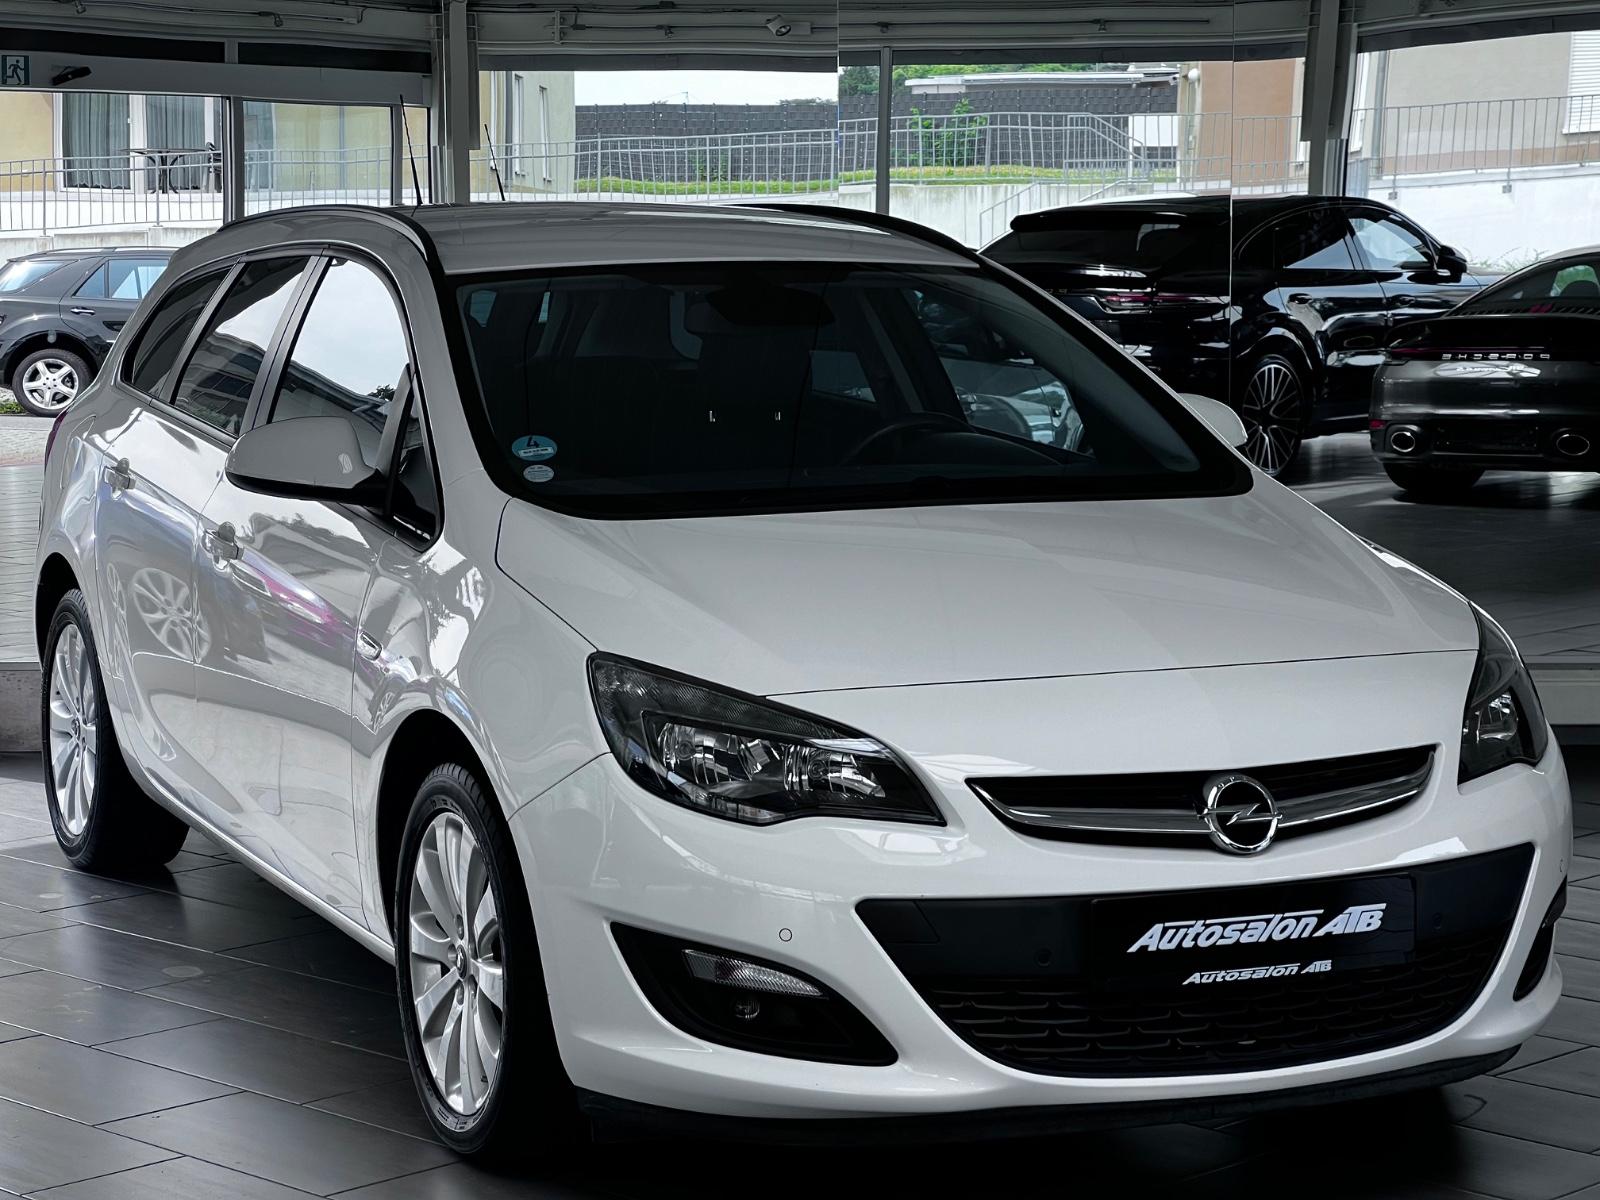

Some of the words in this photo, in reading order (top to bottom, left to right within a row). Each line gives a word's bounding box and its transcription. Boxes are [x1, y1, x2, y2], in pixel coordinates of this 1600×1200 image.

[526, 436, 540, 448] 4
[1127, 909, 1324, 952] Autosalon
[1312, 903, 1387, 937] ATB
[1182, 963, 1301, 985] Autosalon
[1300, 959, 1332, 974] ATB
